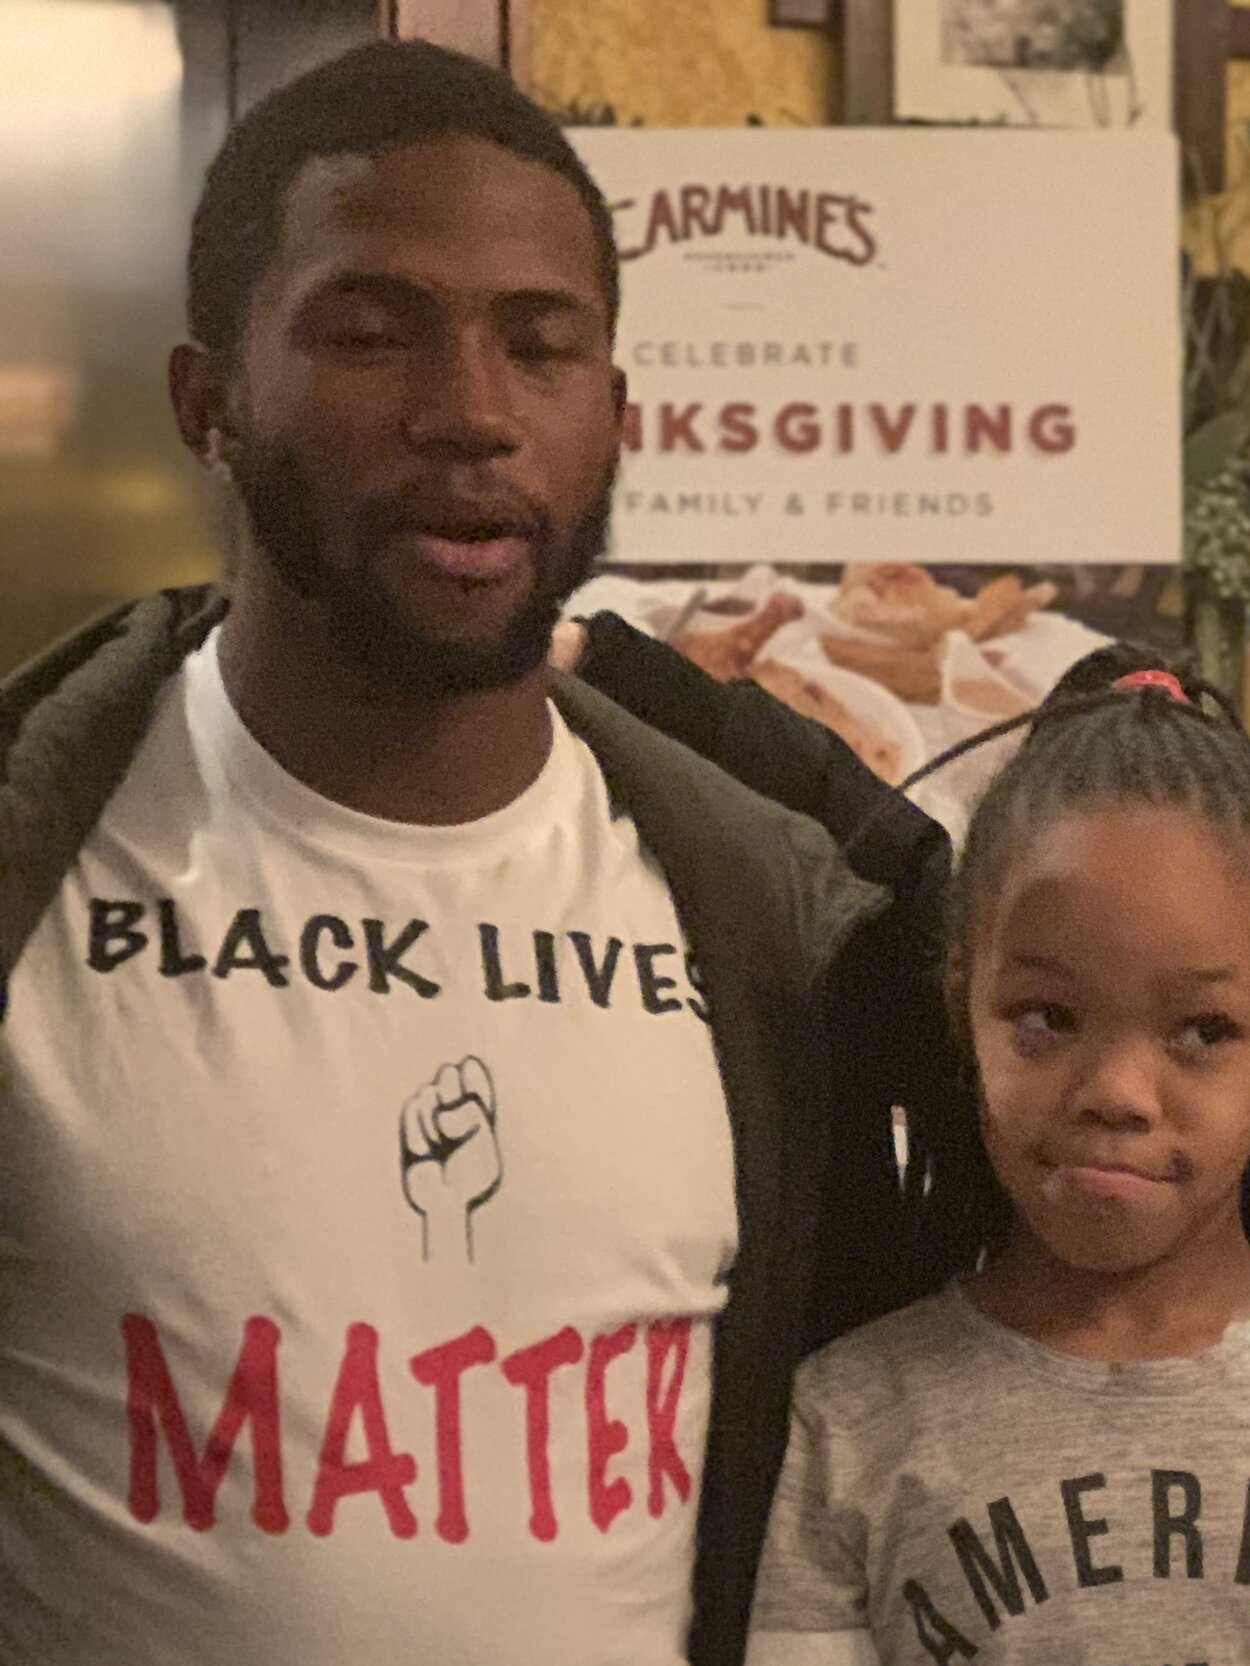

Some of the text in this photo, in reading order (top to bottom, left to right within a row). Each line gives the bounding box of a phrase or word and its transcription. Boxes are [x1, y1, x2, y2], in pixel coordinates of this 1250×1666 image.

[632, 342, 859, 367] CELEBRATE
[624, 492, 993, 516] FAMILY & FRIENDS
[86, 898, 439, 999] BLACK
[120, 1312, 692, 1544] MATTER
